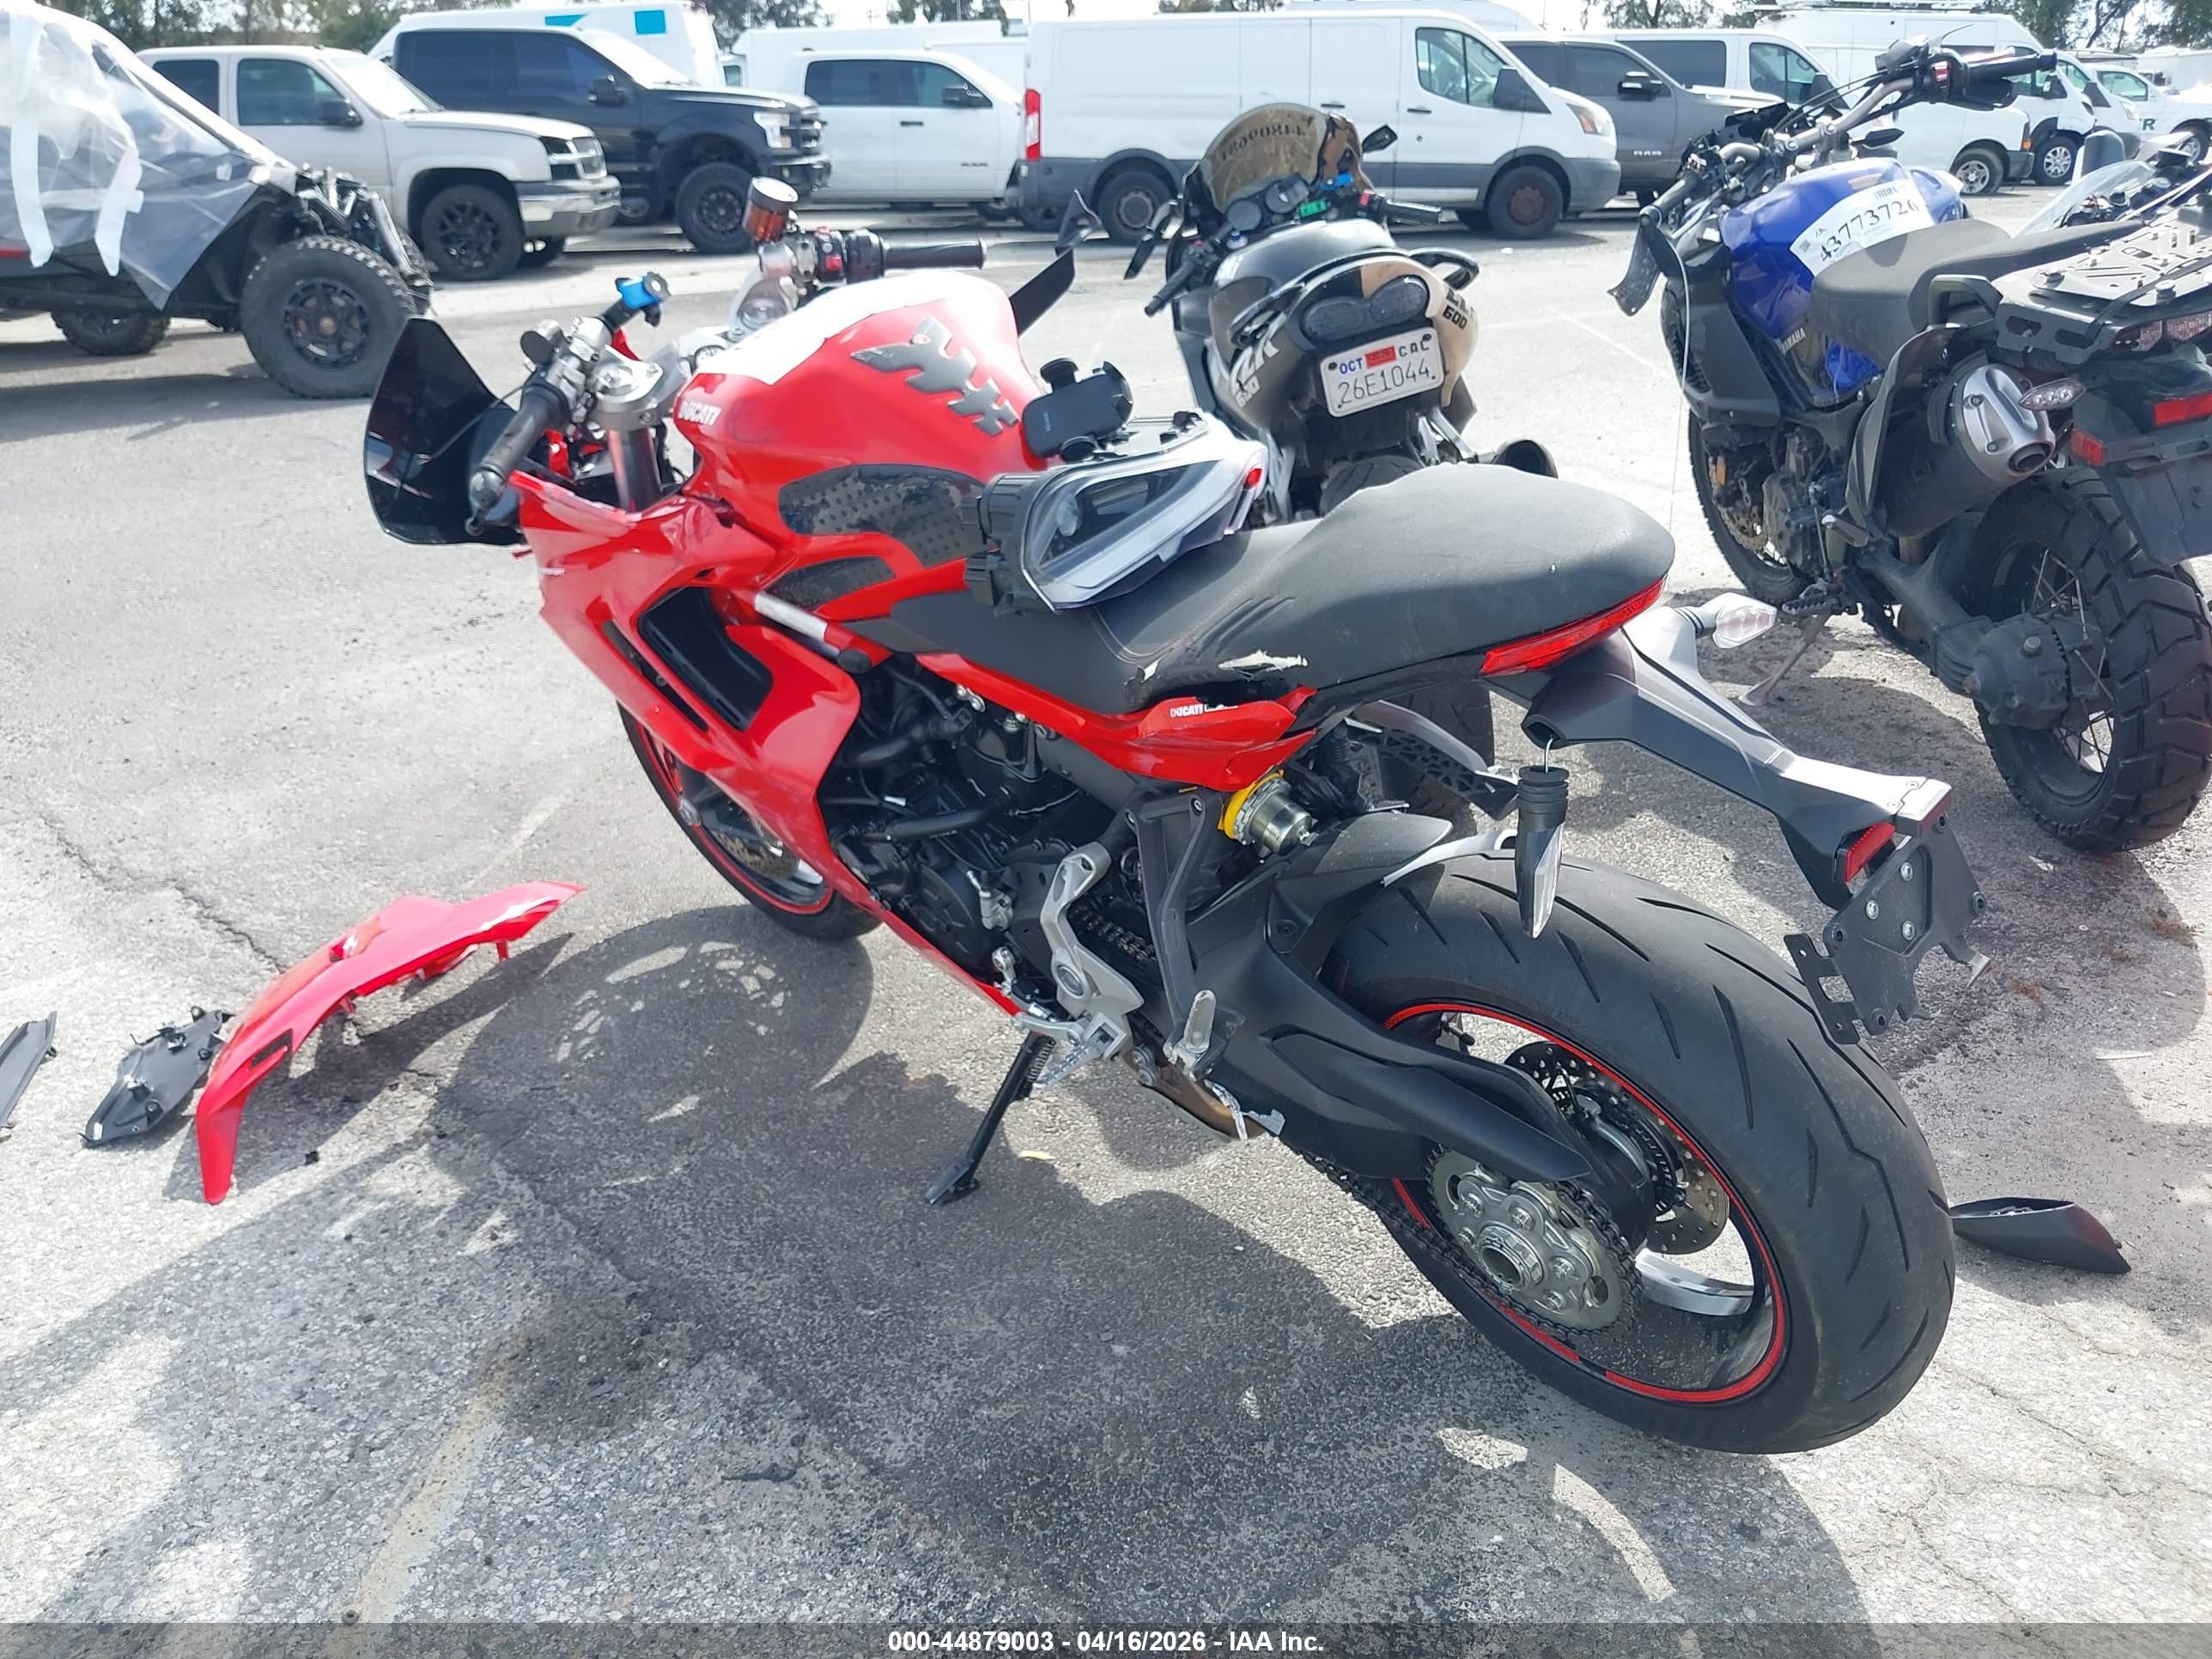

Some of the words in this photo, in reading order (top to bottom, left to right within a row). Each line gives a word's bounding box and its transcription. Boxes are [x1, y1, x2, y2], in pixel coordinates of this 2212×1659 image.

[1443, 304, 1468, 331] 600
[1773, 327, 1806, 354] YAMAHA
[1340, 357, 1363, 374] OCT
[1398, 340, 1430, 357] CAL
[1338, 358, 1431, 404] 26E1044
[678, 399, 722, 426] DUCATI
[1170, 703, 1203, 718] DUCATI
